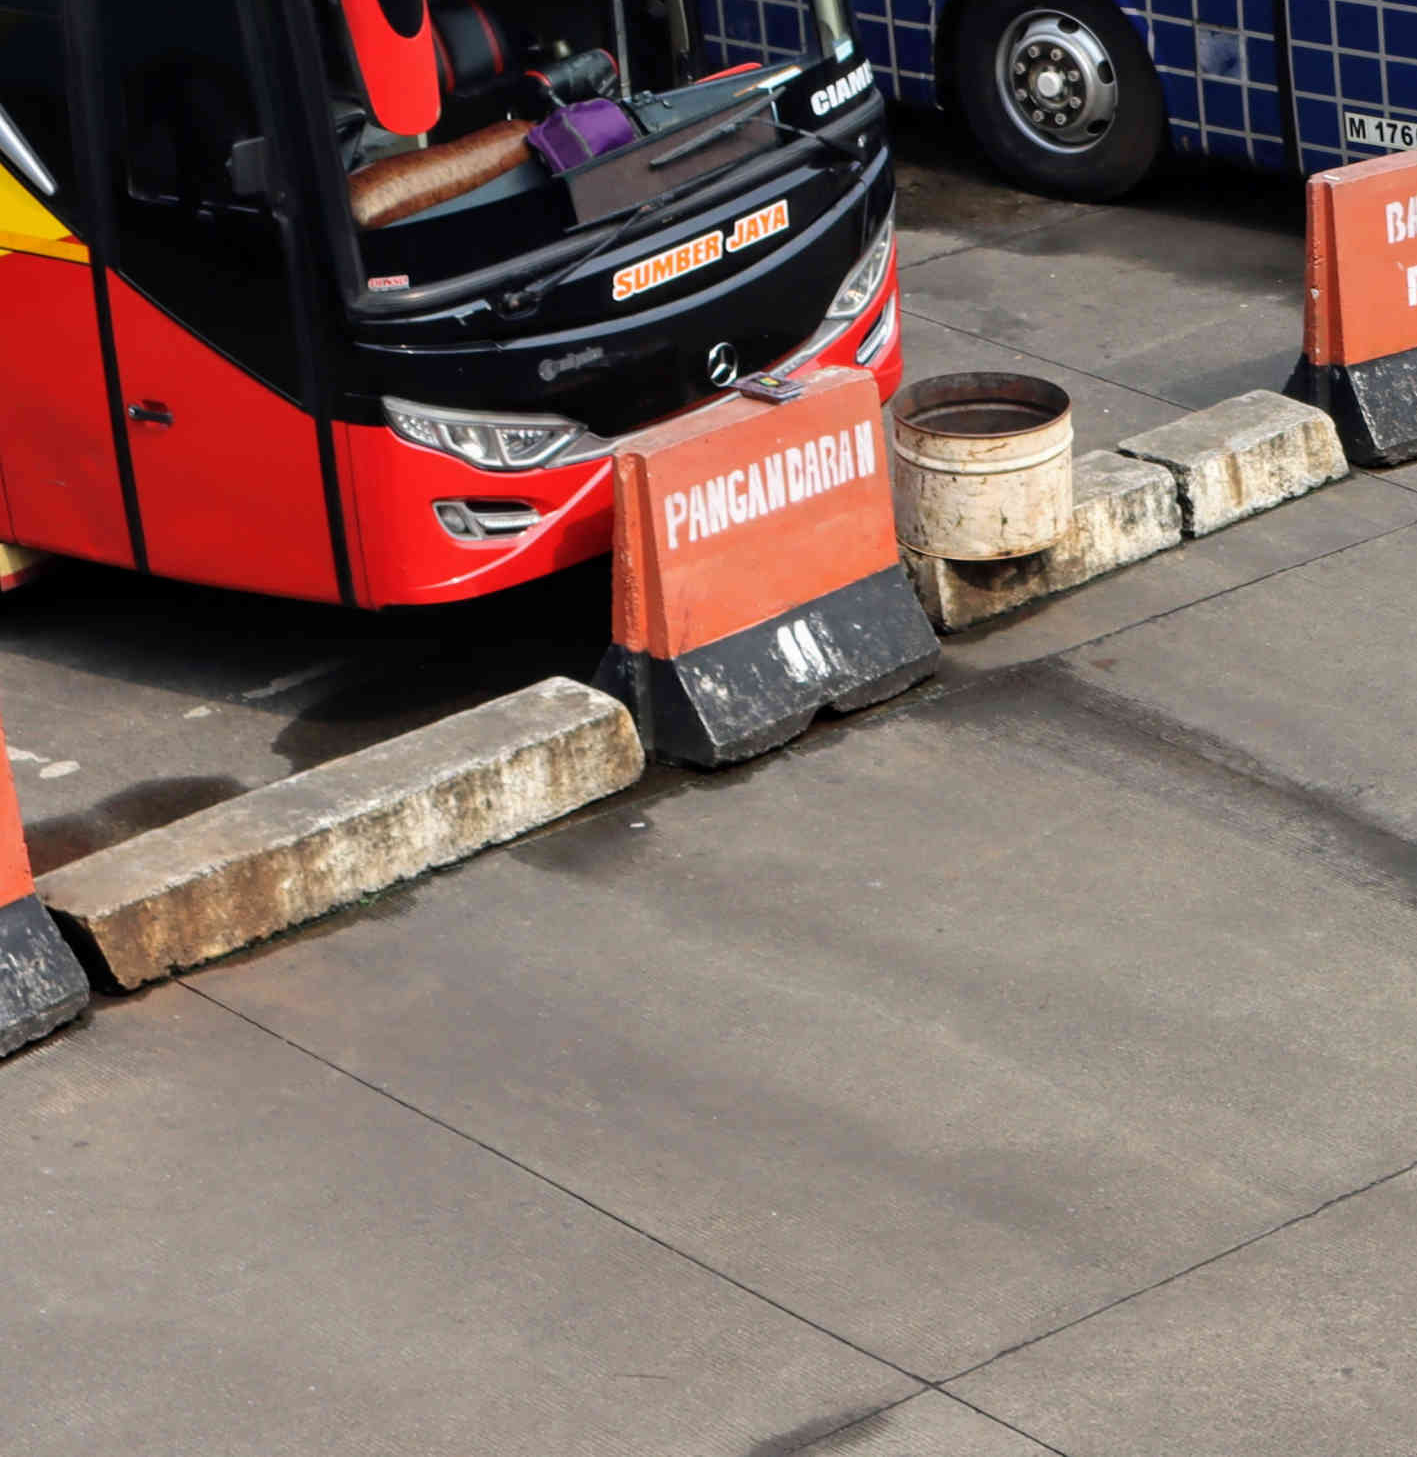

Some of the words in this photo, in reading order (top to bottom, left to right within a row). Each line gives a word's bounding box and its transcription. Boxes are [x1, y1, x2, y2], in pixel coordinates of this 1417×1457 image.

[1349, 117, 1367, 141] M
[614, 232, 722, 300] SUMBER
[727, 202, 788, 251] JAYA
[664, 419, 876, 550] PANGANDARAN
